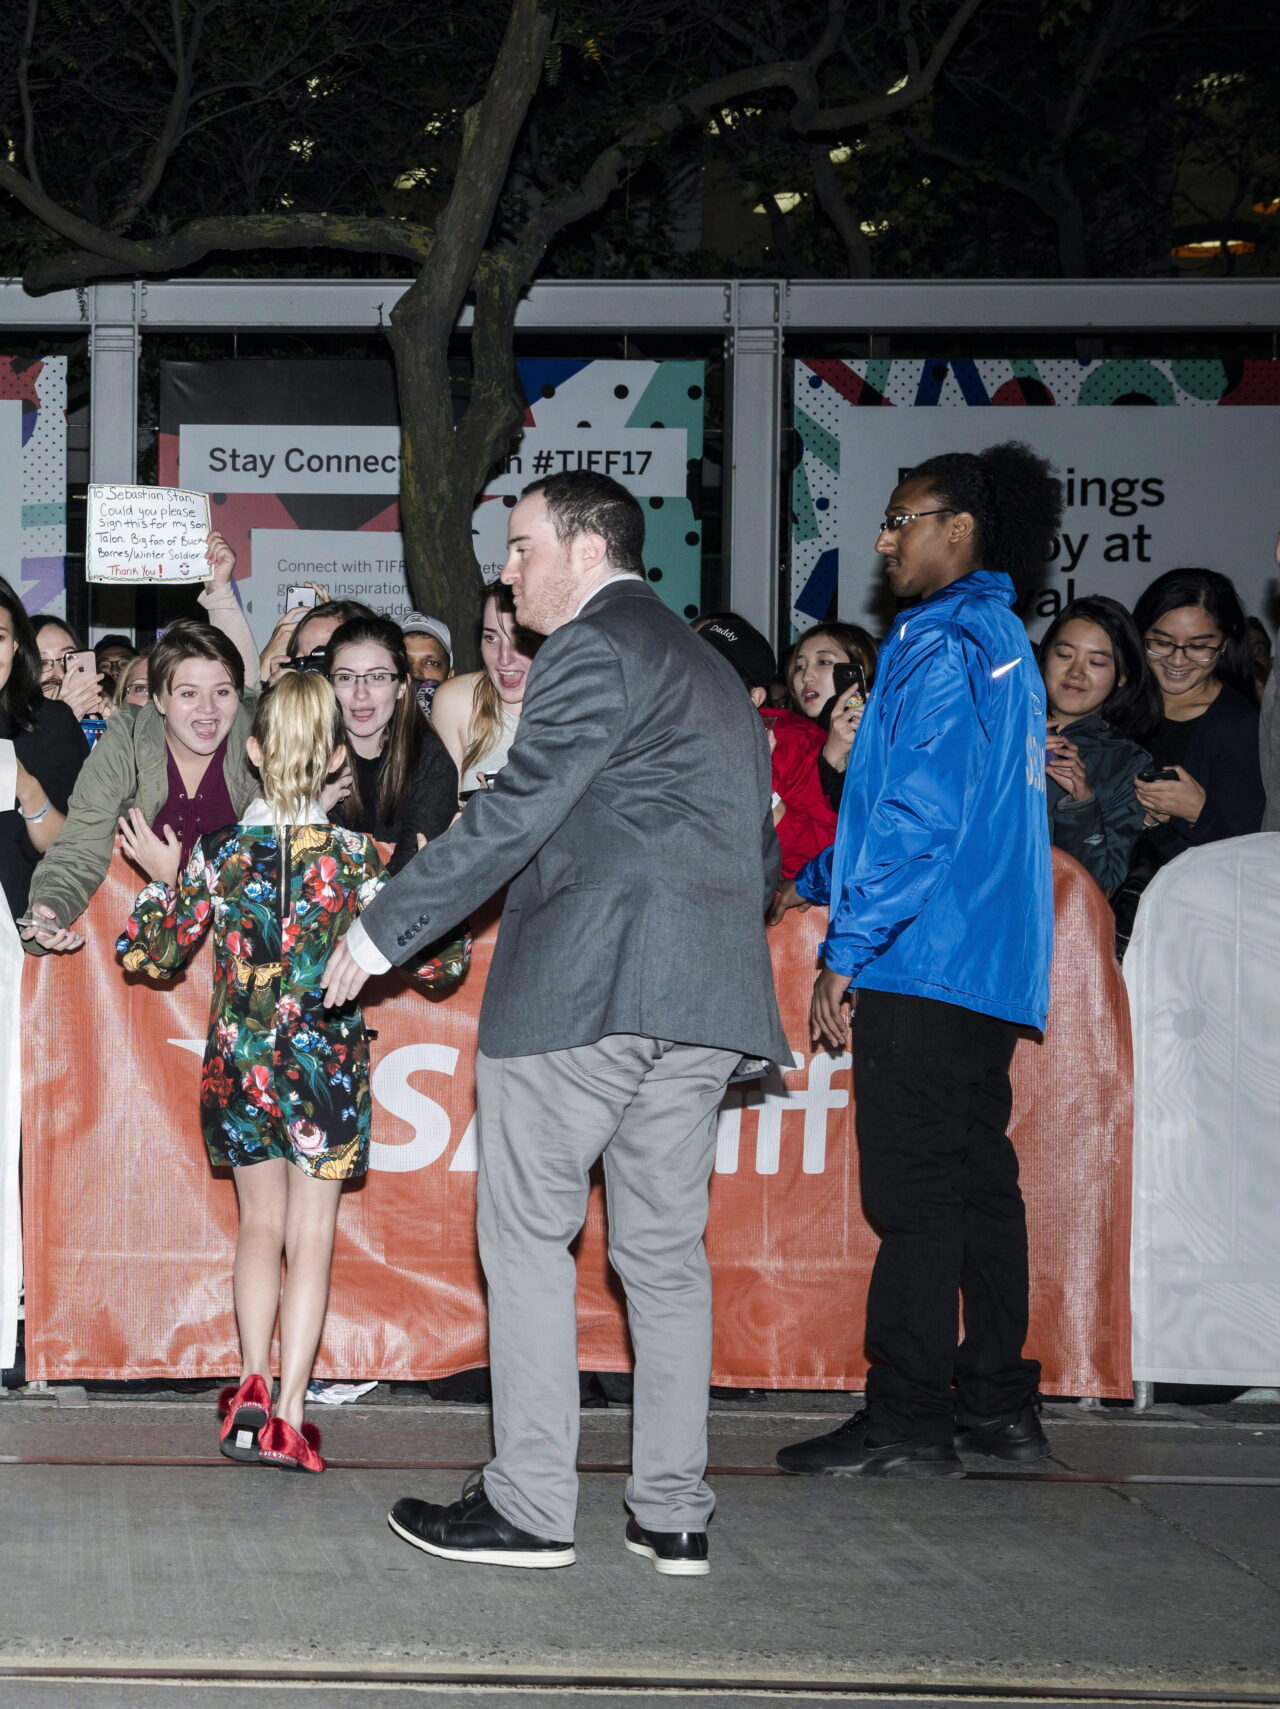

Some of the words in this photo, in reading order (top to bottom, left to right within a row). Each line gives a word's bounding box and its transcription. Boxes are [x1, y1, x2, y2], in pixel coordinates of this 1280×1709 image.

[209, 447, 275, 478] Stay
[284, 447, 400, 473] Connec
[532, 450, 652, 475] #TIFF17
[92, 486, 104, 499] To
[106, 486, 163, 500] Sebastian
[167, 489, 194, 504] Stan,
[100, 502, 133, 517] Could
[138, 507, 157, 520] you
[160, 504, 196, 520] please
[124, 519, 148, 529] this
[150, 518, 167, 529] for
[172, 520, 187, 534] my
[130, 532, 148, 548] Big
[149, 534, 165, 546] fan
[167, 535, 177, 546] of
[181, 535, 206, 547] Buck
[1103, 524, 1152, 562] at
[107, 563, 138, 576] Thank
[278, 559, 337, 573] Connect
[342, 559, 372, 573] with
[375, 559, 407, 573] TIFF
[334, 581, 410, 596] inspiration
[376, 602, 412, 616] adde
[709, 624, 738, 642] Daddy
[715, 1051, 853, 1175] iff
